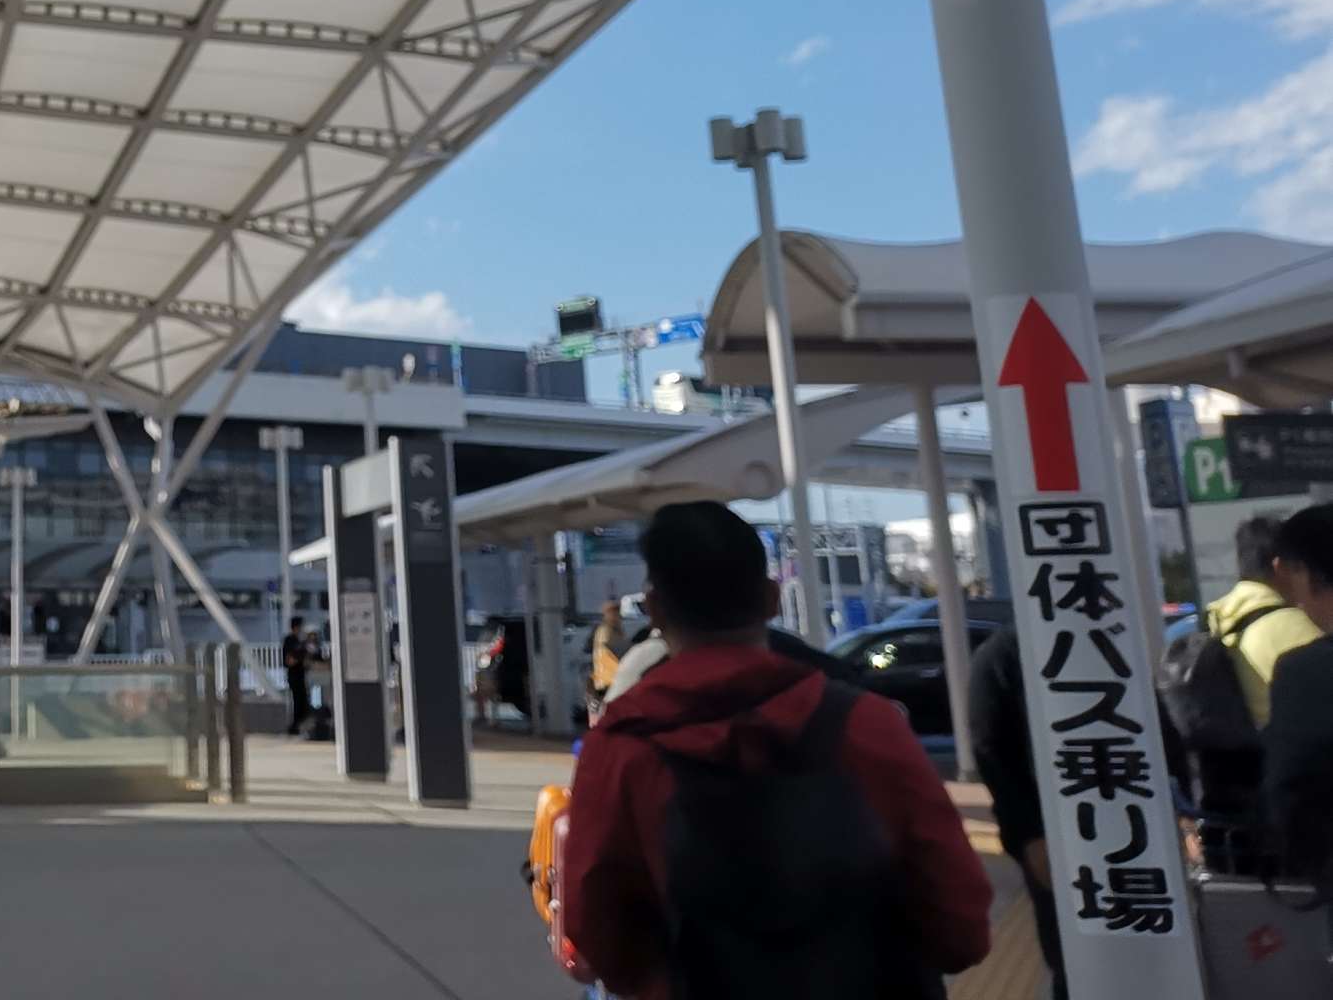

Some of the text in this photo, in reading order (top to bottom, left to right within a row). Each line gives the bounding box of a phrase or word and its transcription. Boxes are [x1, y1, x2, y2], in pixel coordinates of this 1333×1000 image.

[1019, 501, 1174, 934] 団体バス乗り場
